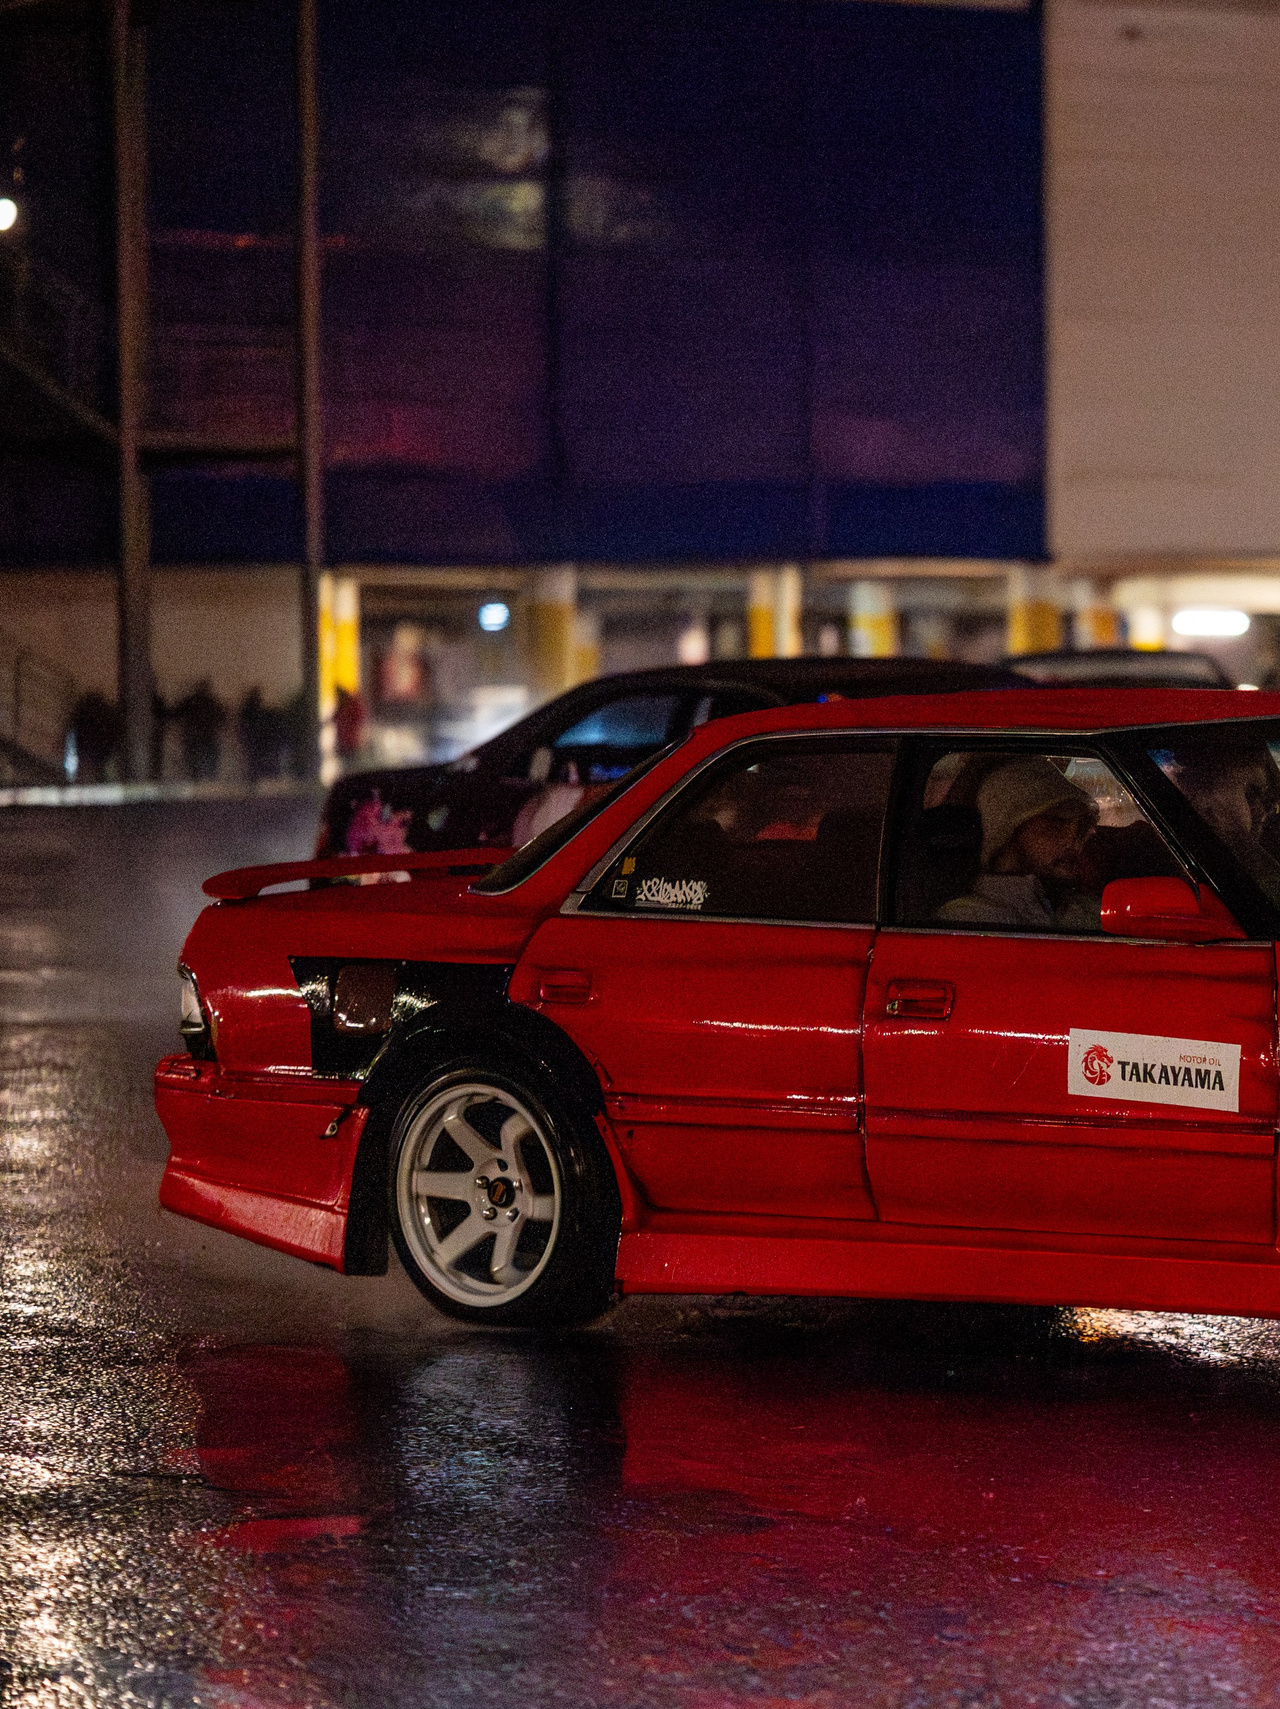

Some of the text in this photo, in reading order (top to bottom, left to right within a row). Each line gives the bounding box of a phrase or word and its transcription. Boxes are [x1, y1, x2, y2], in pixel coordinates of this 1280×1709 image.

[1179, 1053, 1221, 1067] MOTOR OIL
[1117, 1060, 1225, 1092] TAKAYAMA
